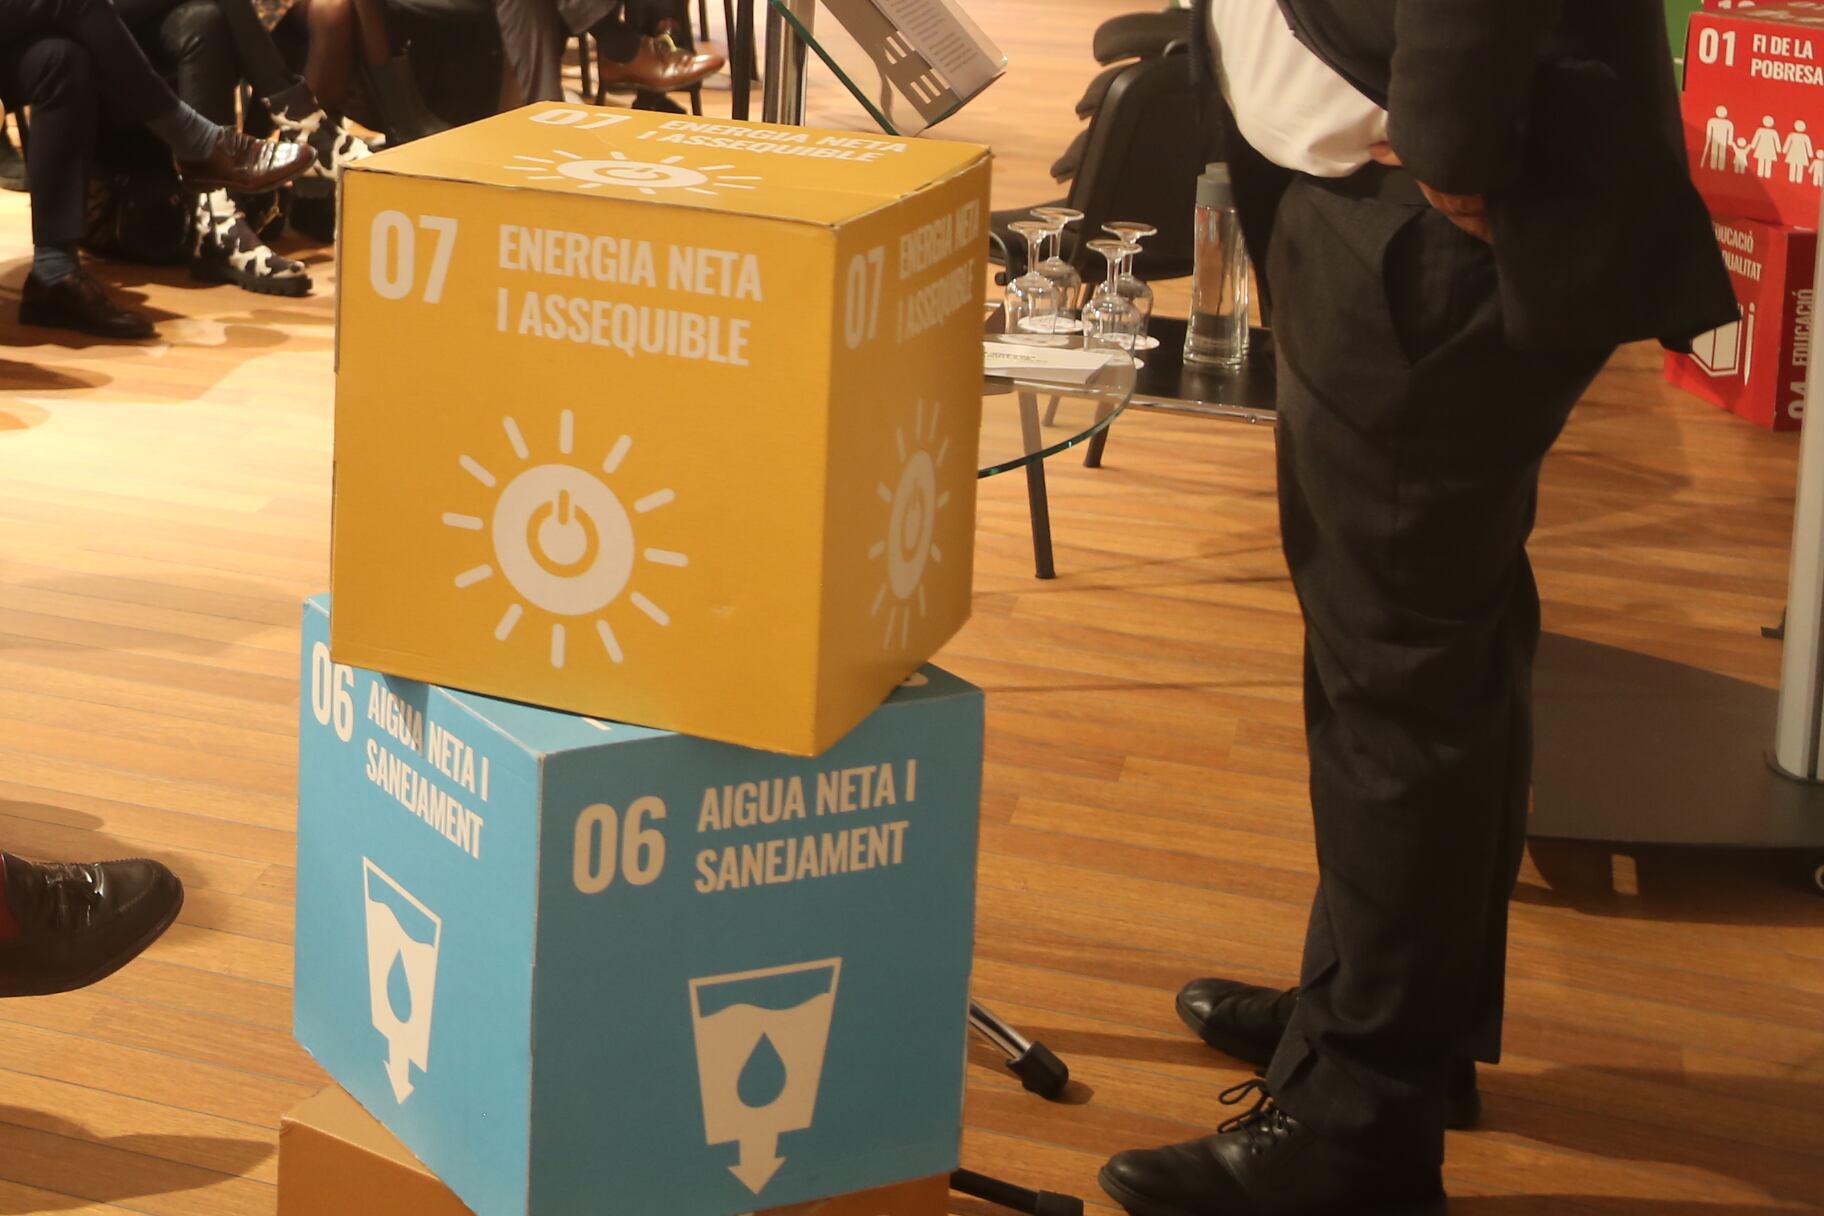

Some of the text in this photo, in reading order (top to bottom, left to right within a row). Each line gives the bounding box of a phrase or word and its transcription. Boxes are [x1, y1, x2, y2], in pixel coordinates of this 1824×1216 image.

[1698, 27, 1736, 67] 01
[1751, 58, 1824, 86] POBRESA
[1753, 34, 1814, 60] FI DE LA
[528, 109, 632, 129] 07
[636, 131, 884, 162] I ASSEQUIBLE
[658, 121, 909, 153] ENERGIA NETA
[369, 210, 458, 304] 07
[499, 224, 764, 302] ENERGIA NETA
[1712, 222, 1754, 253] DUCACIÓ
[496, 286, 751, 368] I ASSEQUIBLE
[844, 245, 885, 350] 07
[311, 641, 355, 743] 06
[368, 680, 490, 802] AIGUA NETA I
[366, 738, 484, 860] SANEJAMENT
[697, 759, 918, 833] AIGUA NETA I
[572, 795, 668, 894] 06
[695, 820, 910, 894] SANEJAMENT
